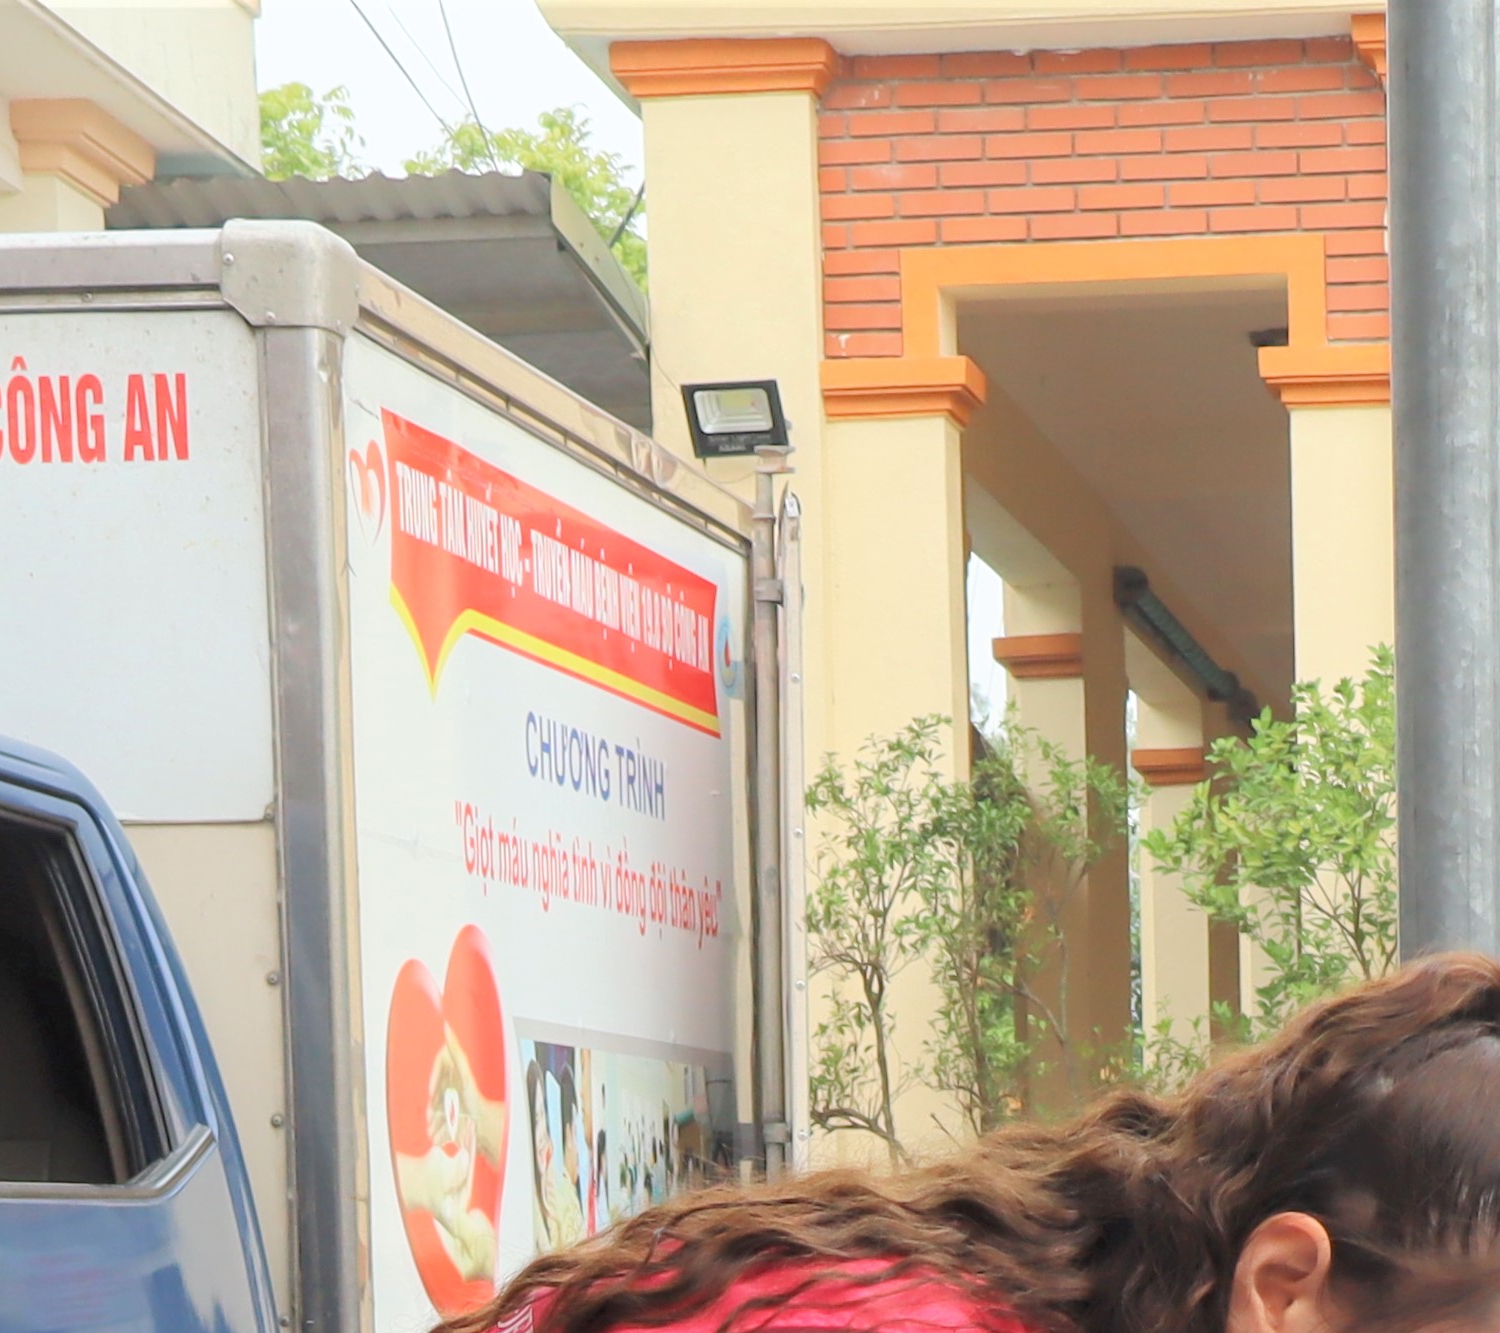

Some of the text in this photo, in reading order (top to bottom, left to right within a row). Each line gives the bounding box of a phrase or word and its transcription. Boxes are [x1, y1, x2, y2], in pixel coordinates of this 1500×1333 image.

[124, 373, 189, 462] AN
[526, 711, 665, 820] CHƯƠNG TRÌNH
[455, 800, 495, 896] "Giọt
[498, 816, 528, 888] máu
[532, 828, 569, 912] nghĩa
[572, 836, 597, 906] tình
[600, 845, 612, 909] vì
[615, 836, 646, 936] đồng
[650, 860, 667, 940] đội
[669, 866, 696, 931] thân
